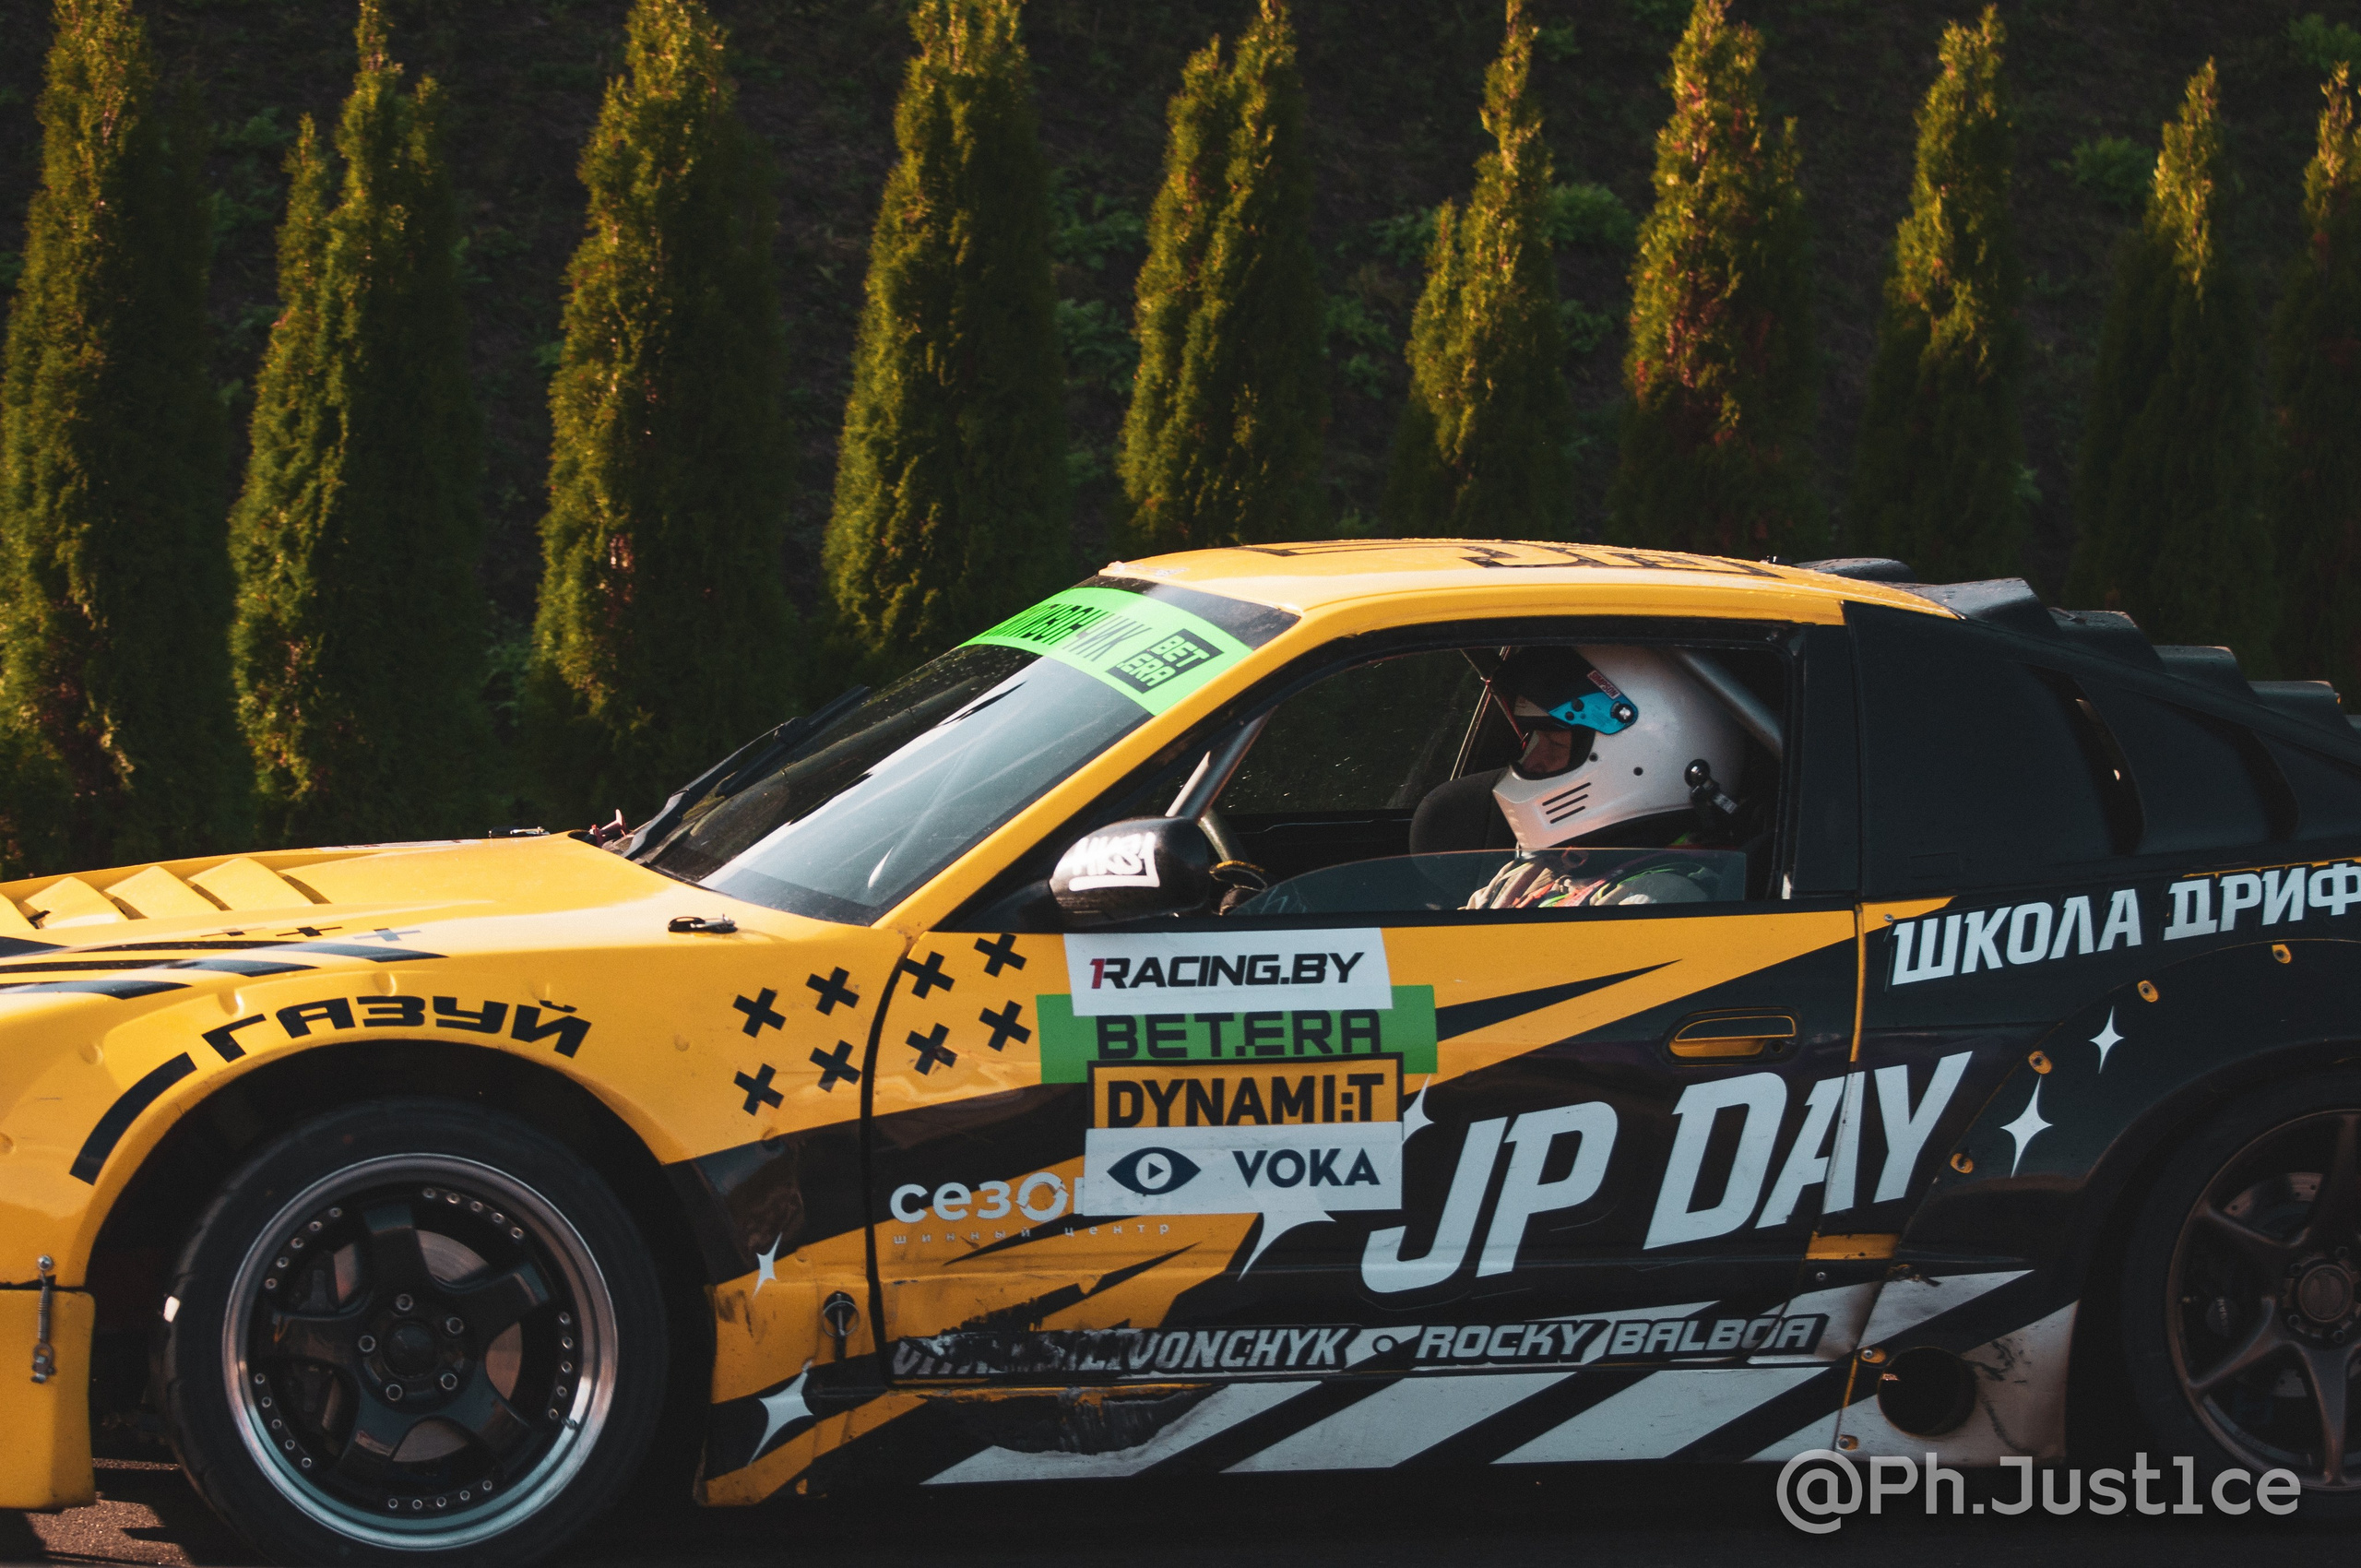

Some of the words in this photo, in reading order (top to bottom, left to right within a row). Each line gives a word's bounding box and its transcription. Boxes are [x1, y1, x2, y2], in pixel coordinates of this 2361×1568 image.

[1150, 635, 1210, 668] BET
[1589, 671, 1619, 697] SIMPSON
[1892, 888, 2142, 986] ШКОЛА
[1089, 952, 1365, 989] 1RACING.BY
[201, 995, 592, 1063] ГАЗУЙ
[1232, 1148, 1381, 1188] VOKA
[1361, 1100, 1619, 1293] JP
[1643, 1051, 1974, 1250] DAY
[893, 1228, 1031, 1245] шинный
[1065, 1223, 1169, 1237] центр
[1416, 1322, 1595, 1360] ROCKY
[1612, 1316, 1817, 1356] BALBOA
